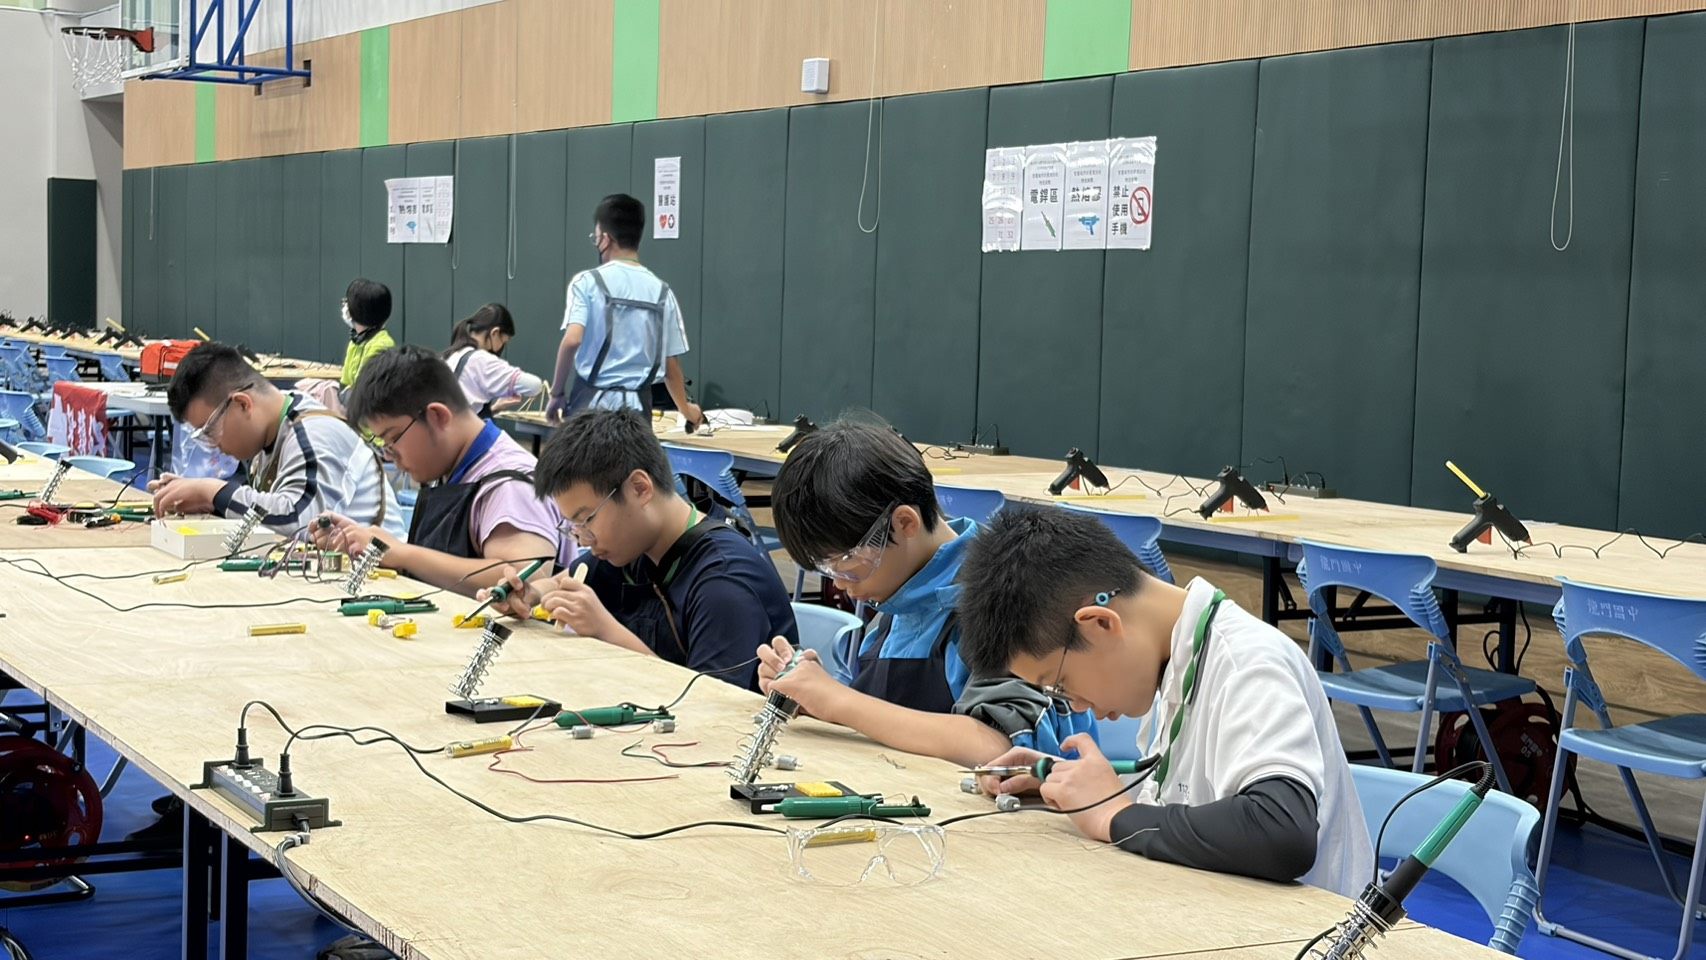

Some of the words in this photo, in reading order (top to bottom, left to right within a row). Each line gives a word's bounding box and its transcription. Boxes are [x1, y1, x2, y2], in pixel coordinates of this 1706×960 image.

[1113, 185, 1129, 198] 禁止
[1112, 203, 1128, 217] 使用
[1112, 222, 1128, 235] 手機
